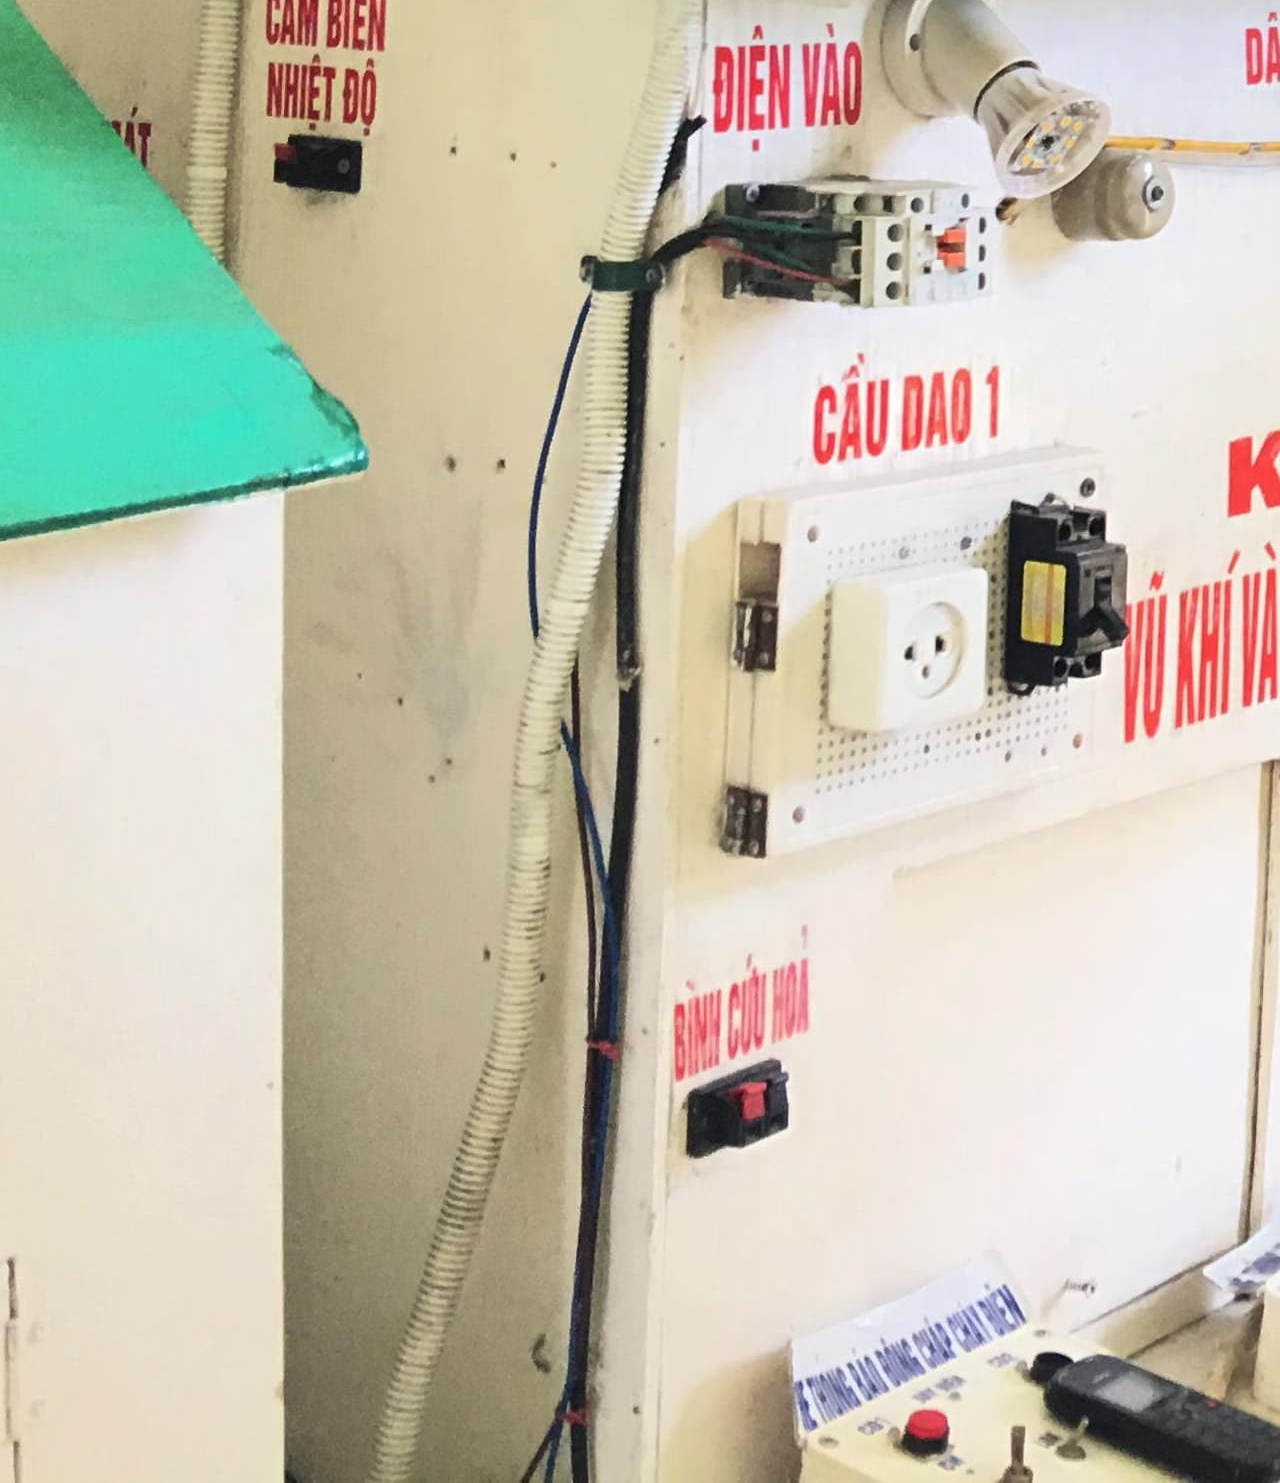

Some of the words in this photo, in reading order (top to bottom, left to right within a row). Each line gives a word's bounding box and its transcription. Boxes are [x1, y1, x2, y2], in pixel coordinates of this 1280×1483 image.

[266, 54, 336, 131] NHIỆT
[343, 58, 377, 136] ĐỘ
[713, 25, 791, 142] ĐIỆN
[802, 23, 862, 127] VÀO
[813, 352, 890, 465] CẦU
[901, 367, 972, 451] DAO
[986, 365, 1000, 438] 1
[1124, 570, 1168, 743] VŨ
[1174, 550, 1240, 730] KHÍ
[1242, 542, 1278, 708] VÀ
[674, 980, 722, 1081] BÌNH
[728, 953, 767, 1059] CỨU
